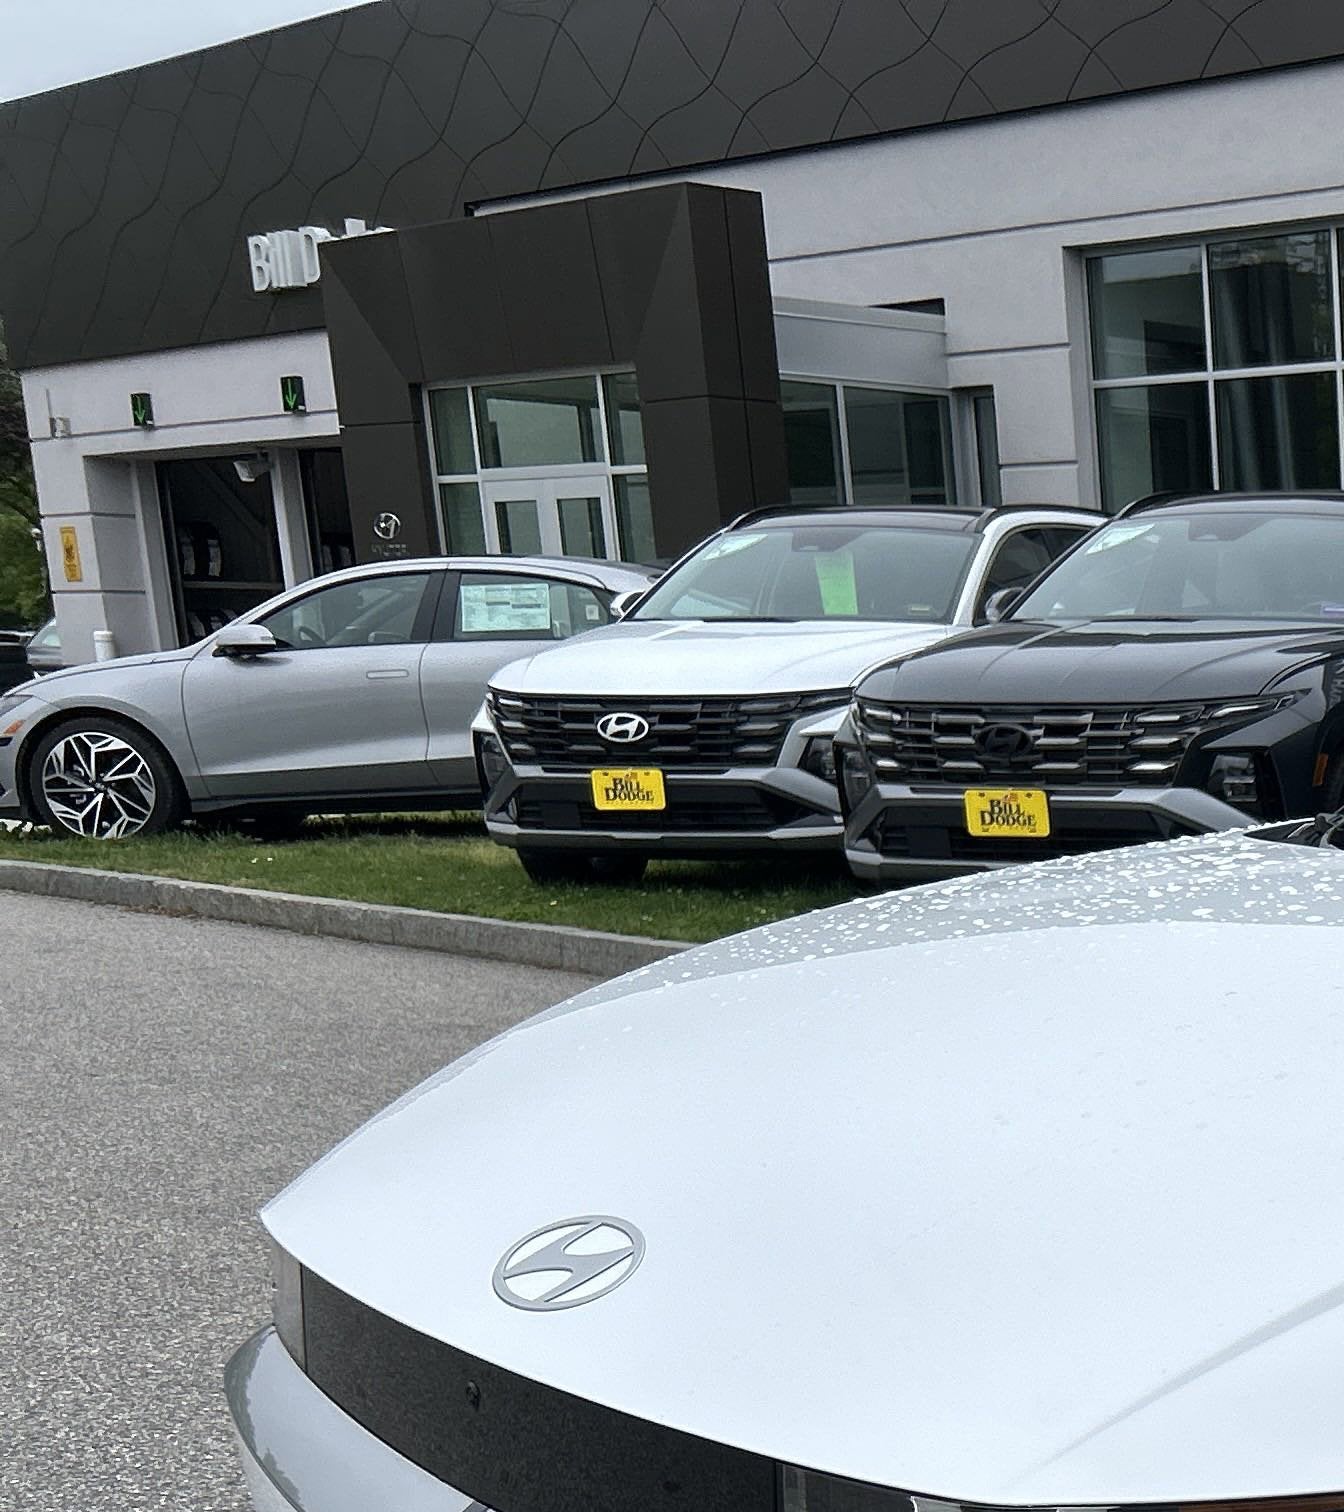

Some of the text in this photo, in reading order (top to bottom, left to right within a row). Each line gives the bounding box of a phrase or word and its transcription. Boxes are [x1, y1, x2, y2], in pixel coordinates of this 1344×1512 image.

[612, 778, 645, 792] BILL
[604, 787, 654, 801] DODGE
[989, 800, 1026, 815] BILL
[980, 810, 1037, 826] DODGE
